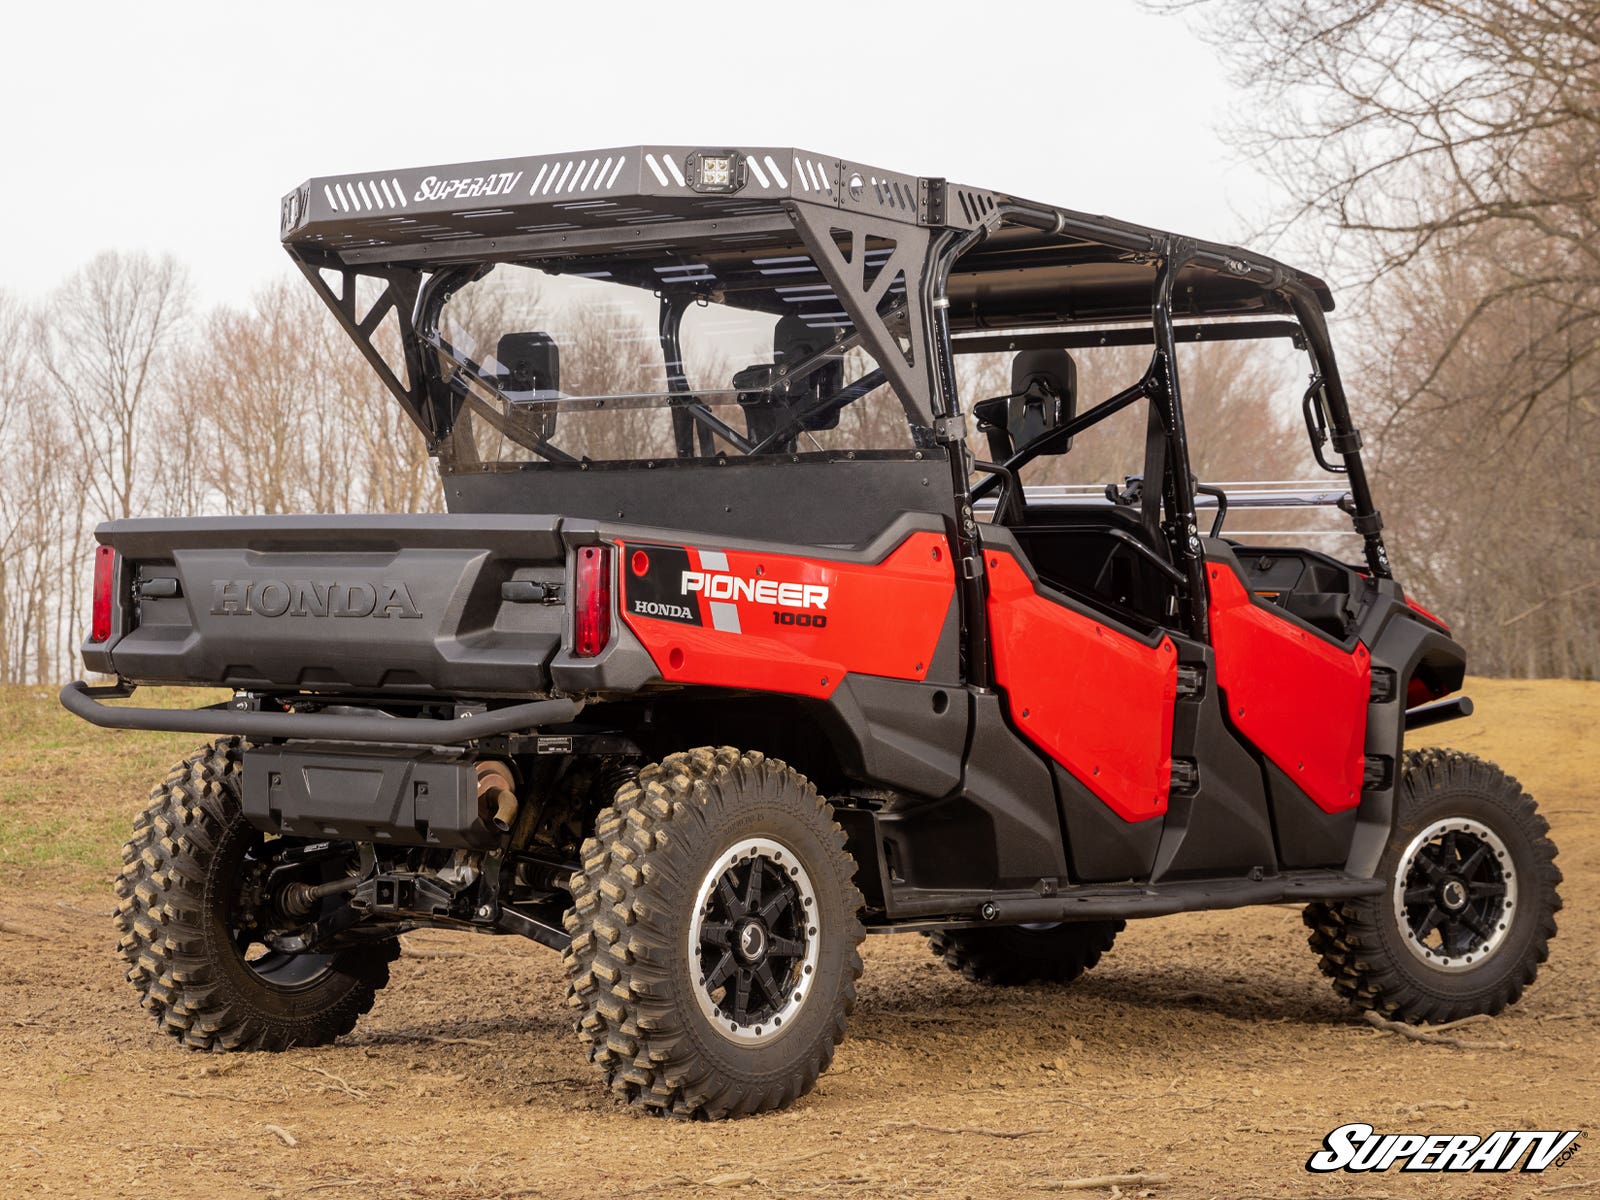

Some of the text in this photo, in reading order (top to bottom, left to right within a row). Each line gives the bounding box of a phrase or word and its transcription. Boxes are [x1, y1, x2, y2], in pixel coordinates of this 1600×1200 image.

[414, 171, 523, 202] SUPERATV
[209, 580, 423, 619] HONDA
[681, 570, 829, 609] PIONEER
[634, 600, 693, 619] HONDA
[772, 611, 827, 628] 1000
